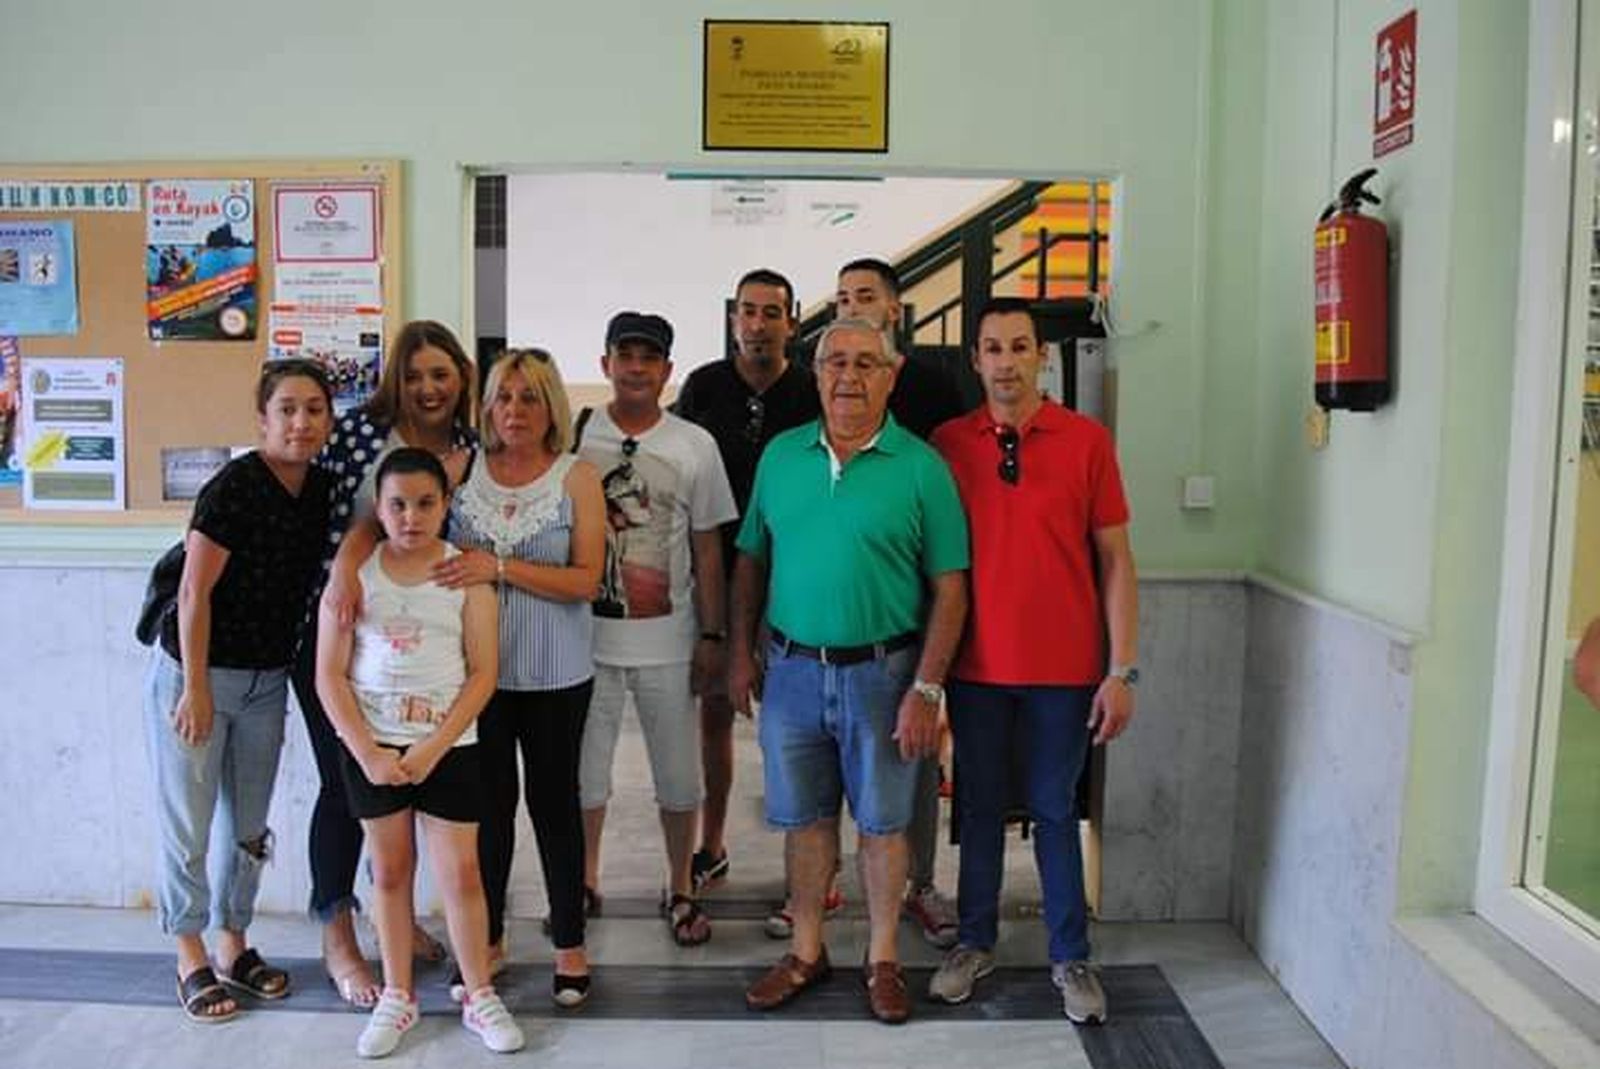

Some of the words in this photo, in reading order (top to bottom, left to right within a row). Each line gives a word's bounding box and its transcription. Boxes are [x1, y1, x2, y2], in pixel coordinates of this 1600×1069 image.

[153, 186, 187, 200] Ruta
[153, 204, 171, 215] en
[176, 201, 220, 218] Kayak
